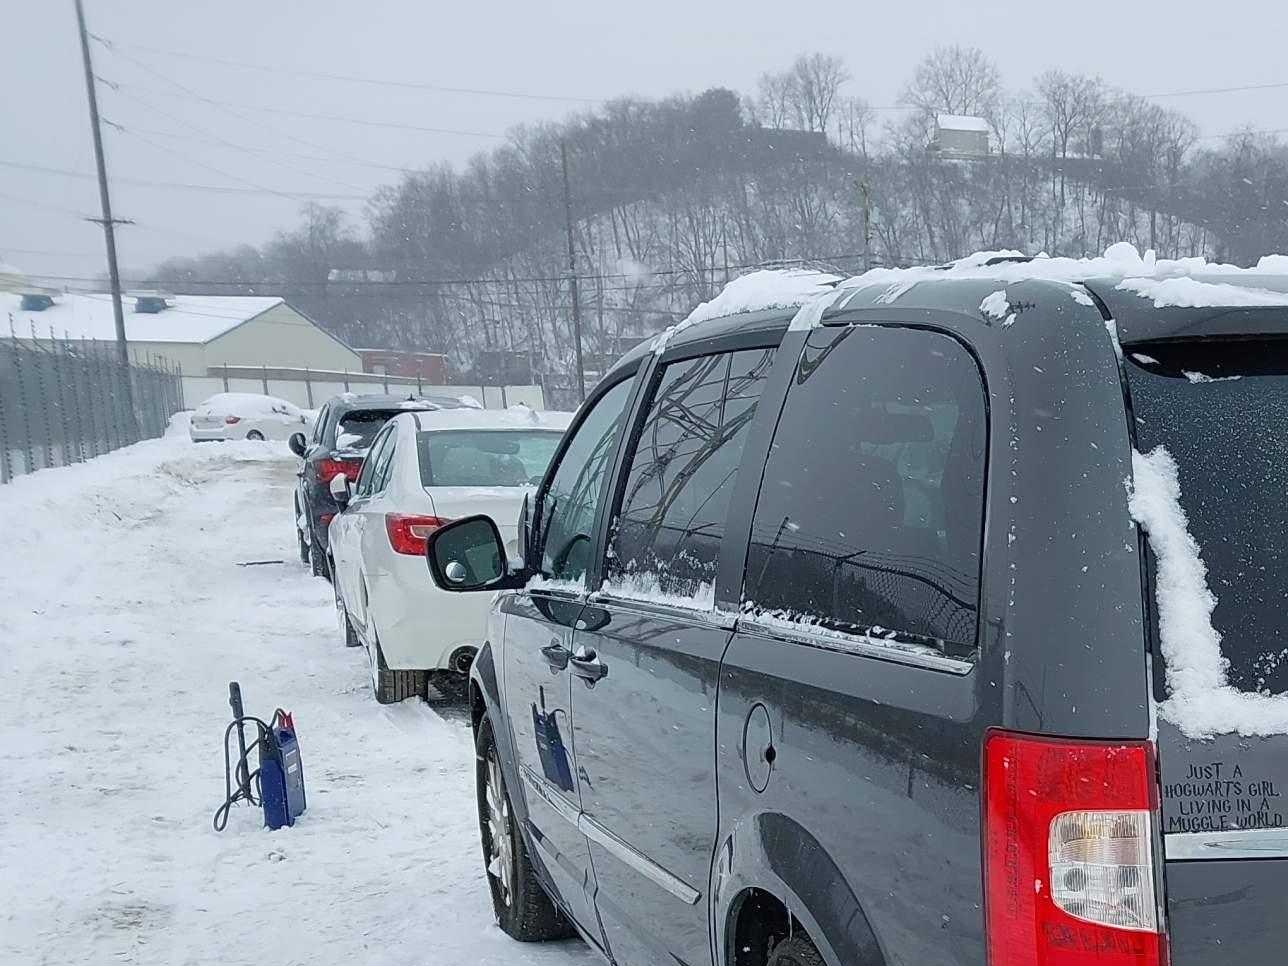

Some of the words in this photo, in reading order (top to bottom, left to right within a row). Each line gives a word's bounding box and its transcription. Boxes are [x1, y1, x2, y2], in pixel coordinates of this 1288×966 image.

[1186, 762, 1223, 780] JUST
[1233, 764, 1243, 779] A
[1165, 780, 1242, 799] HOGWARTS
[1248, 780, 1280, 797] GIRL
[1180, 799, 1231, 816] LIVING
[1237, 798, 1251, 814] IN
[1260, 798, 1270, 811] A
[1169, 814, 1228, 833] MUGGLE
[1236, 811, 1283, 829] WORLD
